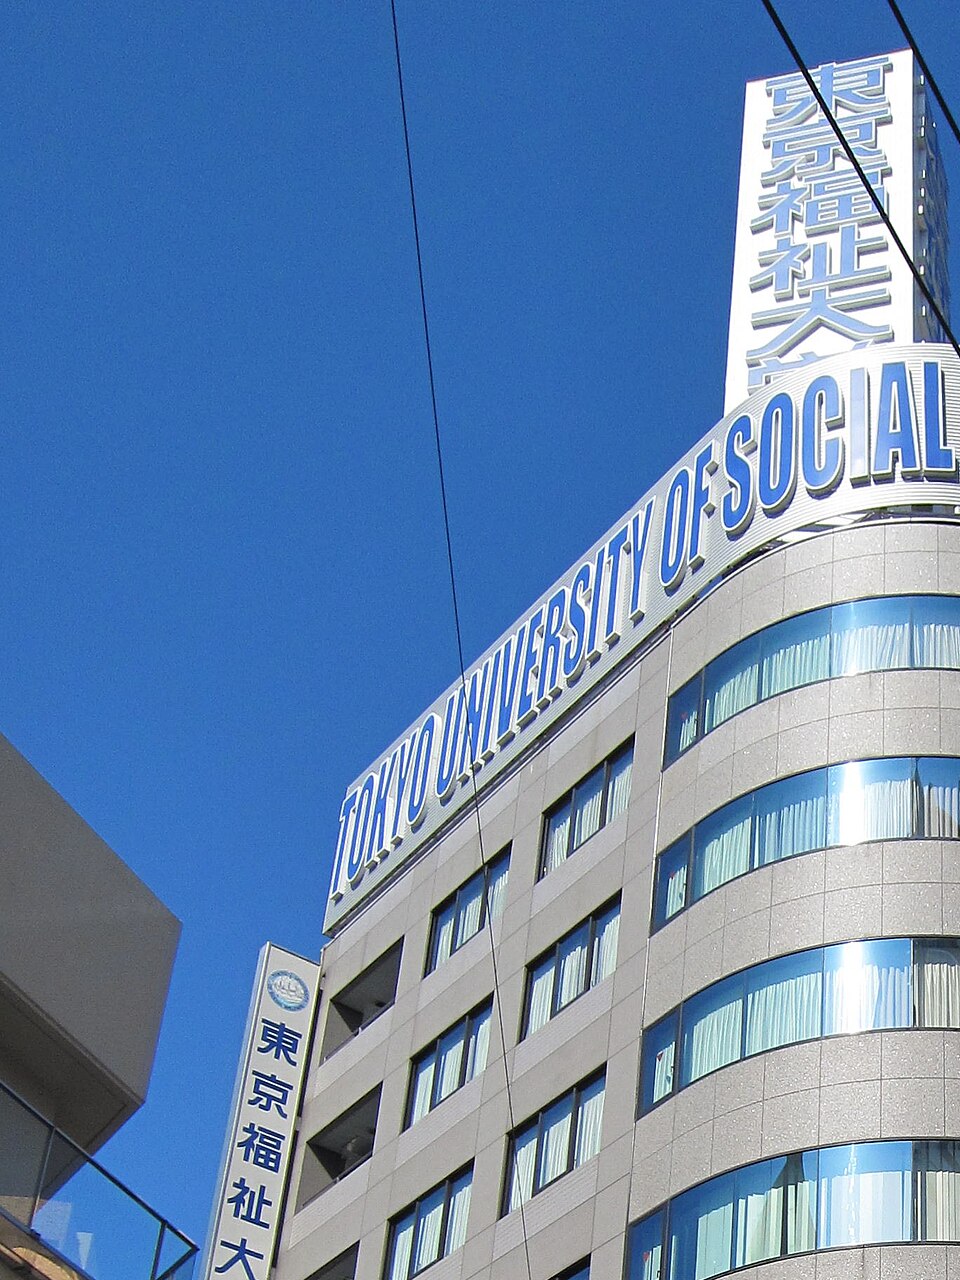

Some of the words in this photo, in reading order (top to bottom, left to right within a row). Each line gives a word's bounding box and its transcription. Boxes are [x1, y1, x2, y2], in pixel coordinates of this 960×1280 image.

[331, 711, 438, 903] TOKYO
[433, 493, 659, 806] UNIVERSITY
[658, 439, 720, 591] OF
[720, 360, 958, 537] SOCIAL
